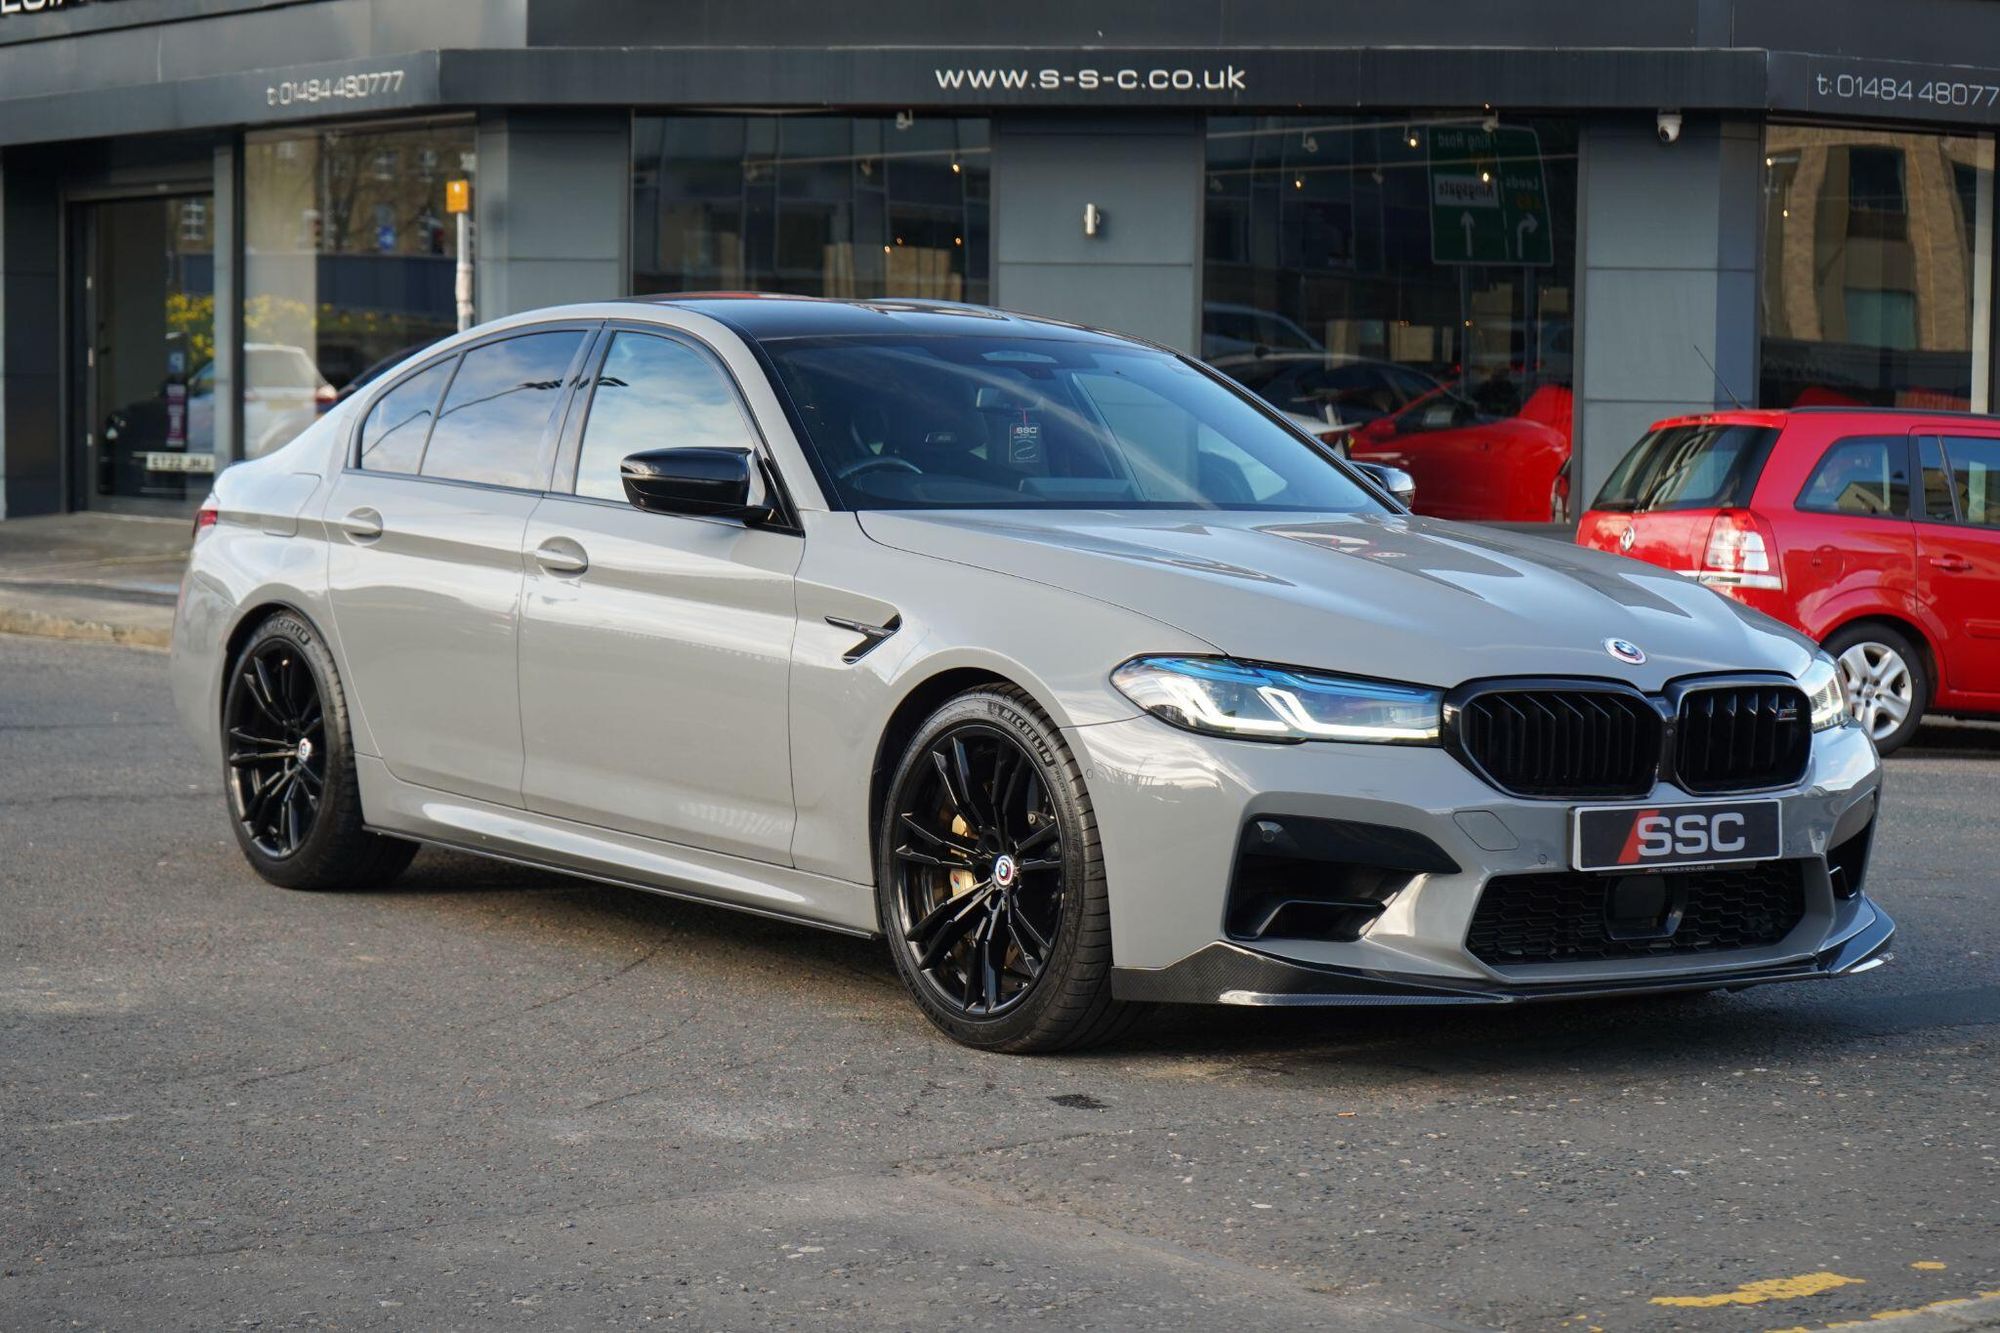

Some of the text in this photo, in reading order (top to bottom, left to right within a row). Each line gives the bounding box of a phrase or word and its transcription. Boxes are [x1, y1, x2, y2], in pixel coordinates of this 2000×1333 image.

[935, 65, 1246, 89] www.s-s-c.co.uk
[1837, 74, 1914, 101] 01484
[1001, 708, 1056, 767] MICHELIN
[1636, 811, 1746, 857] SSC
